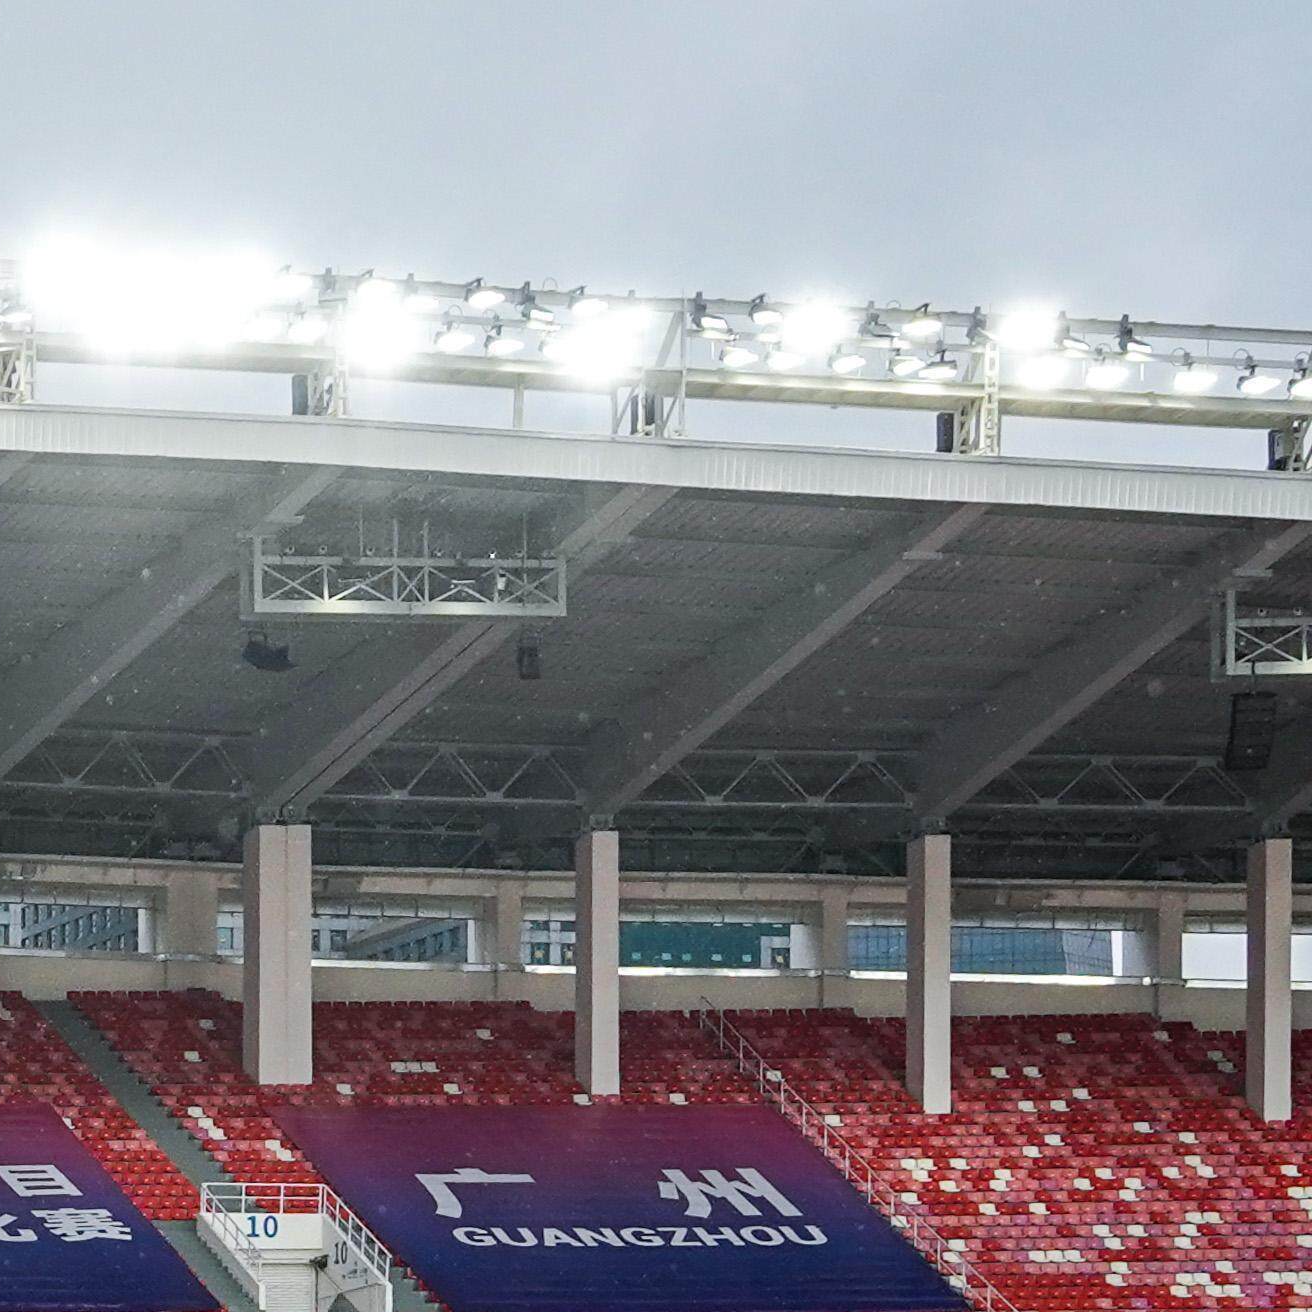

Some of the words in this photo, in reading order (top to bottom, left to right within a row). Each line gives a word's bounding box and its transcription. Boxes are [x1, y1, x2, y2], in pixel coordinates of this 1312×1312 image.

[415, 1167, 804, 1218] 广州
[245, 1214, 279, 1239] 10
[452, 1224, 829, 1248] GUANGZHOU
[333, 1241, 348, 1265] 10
